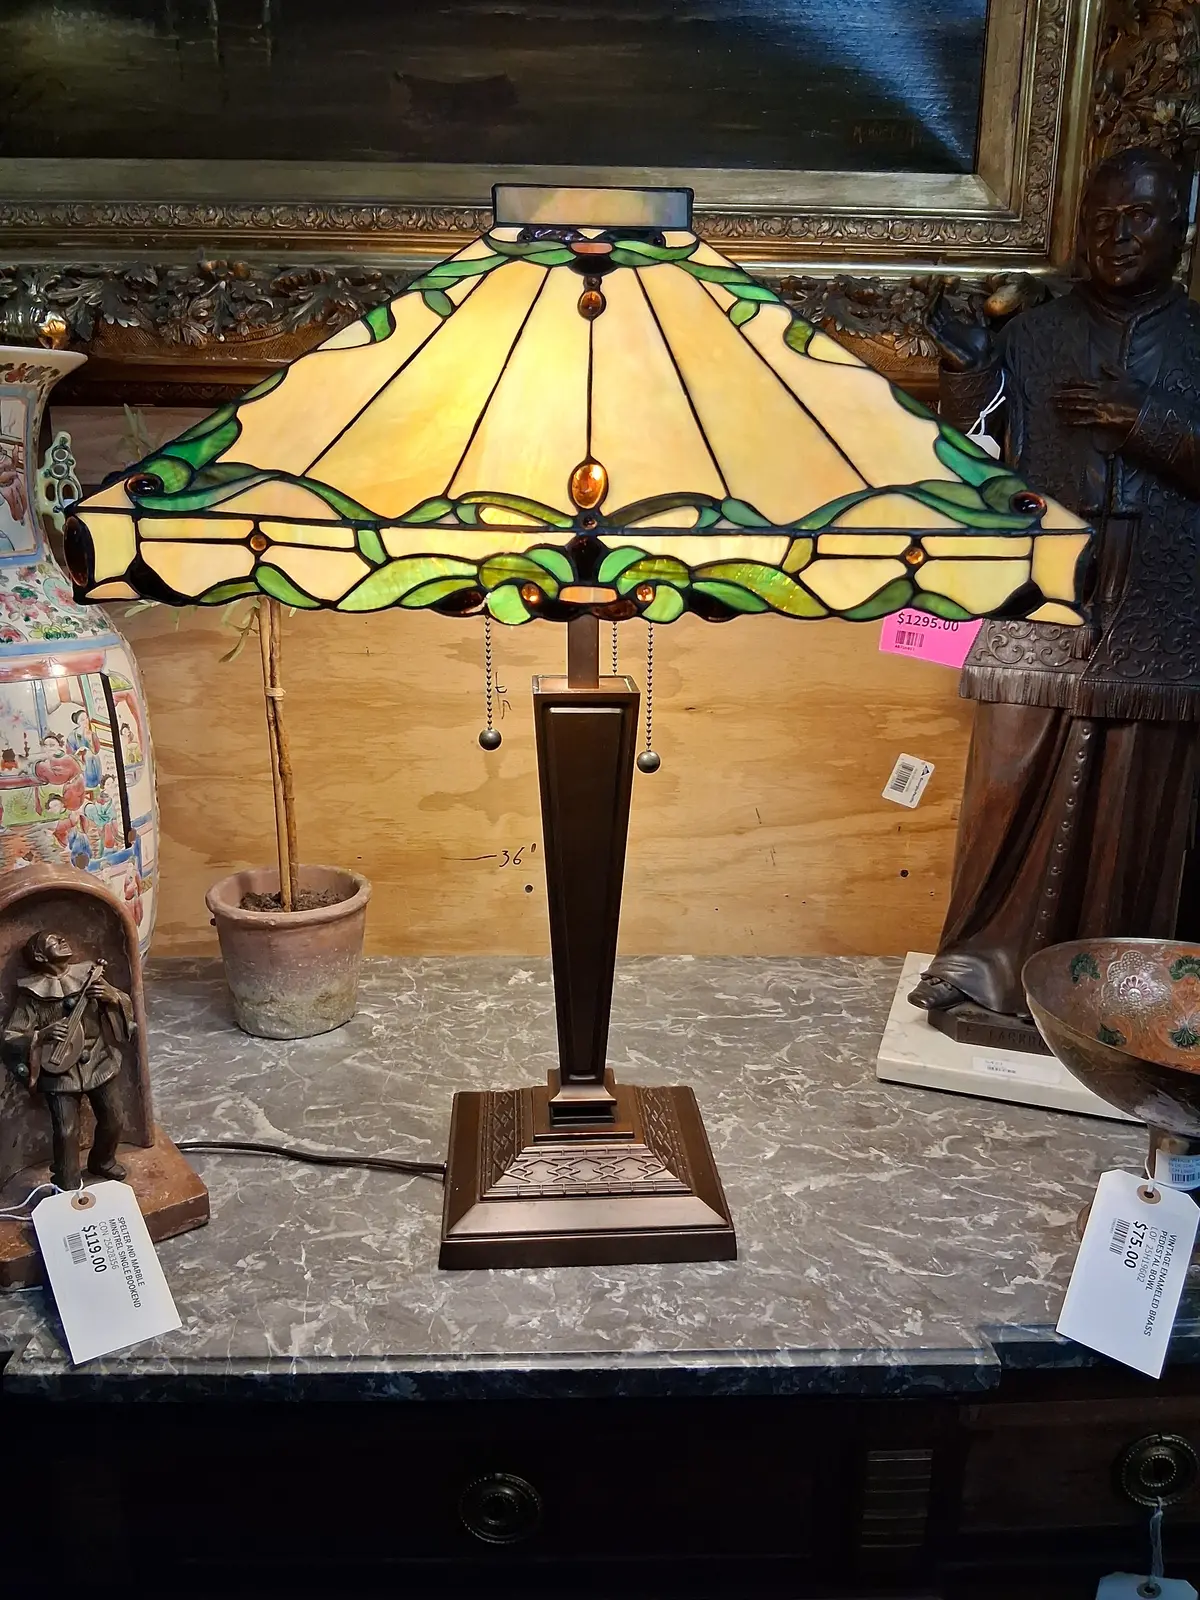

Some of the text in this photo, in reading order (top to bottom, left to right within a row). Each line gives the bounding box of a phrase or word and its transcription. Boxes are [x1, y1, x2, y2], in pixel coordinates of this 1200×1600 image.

[897, 612, 959, 632] $1295.00
[81, 1224, 107, 1273] $119.00
[99, 1221, 119, 1270] CON 25A28356
[109, 1218, 141, 1308] MINSTREL SINGLE BOOKEND
[118, 1216, 145, 1287] SPELTER AND MARBLE
[1124, 1220, 1148, 1269] $75.00
[1136, 1244, 1153, 1283] 25H19602
[1145, 1230, 1168, 1291] PEDESTAL BOWL
[1144, 1234, 1177, 1337] VINTAGE ENAMELED BRASS
